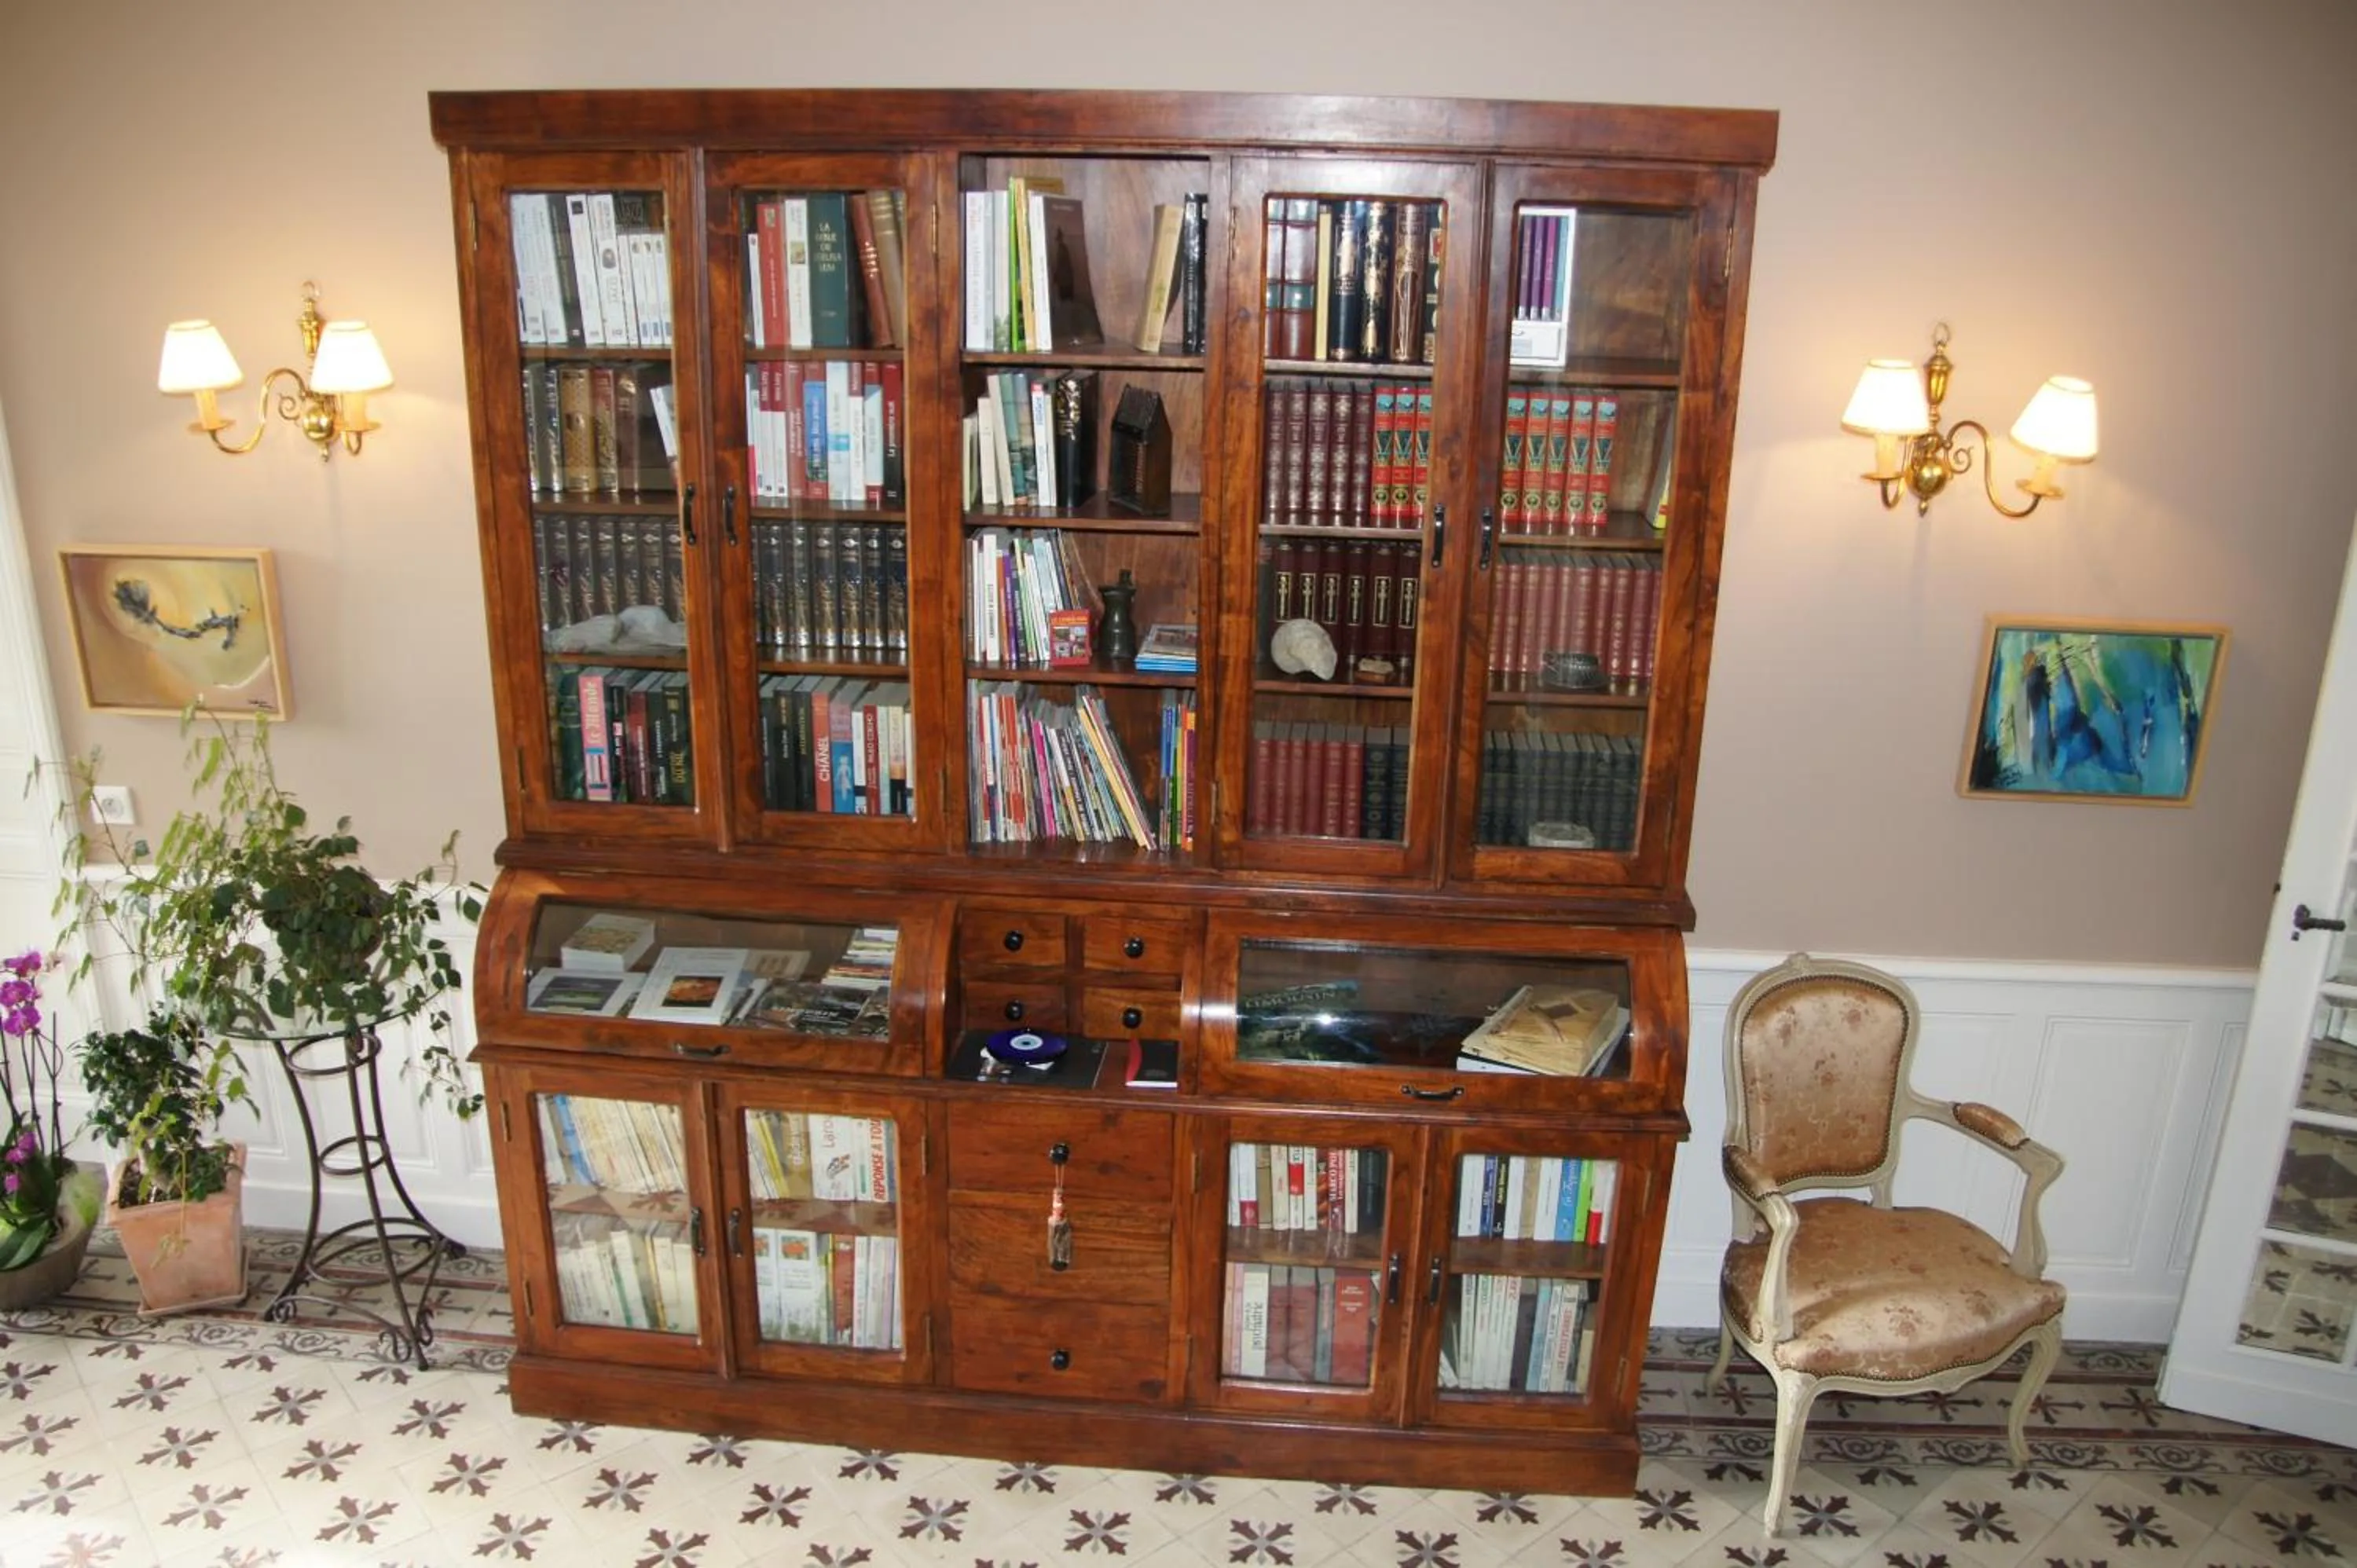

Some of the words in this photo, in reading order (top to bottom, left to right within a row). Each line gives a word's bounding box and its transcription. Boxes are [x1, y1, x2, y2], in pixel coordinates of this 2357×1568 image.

[819, 222, 831, 232] LA
[585, 681, 600, 730] Monde
[588, 731, 603, 744] Le
[817, 735, 830, 782] CHANEL
[1245, 991, 1336, 1009] LIMOUSIN
[823, 1118, 835, 1149] Laro
